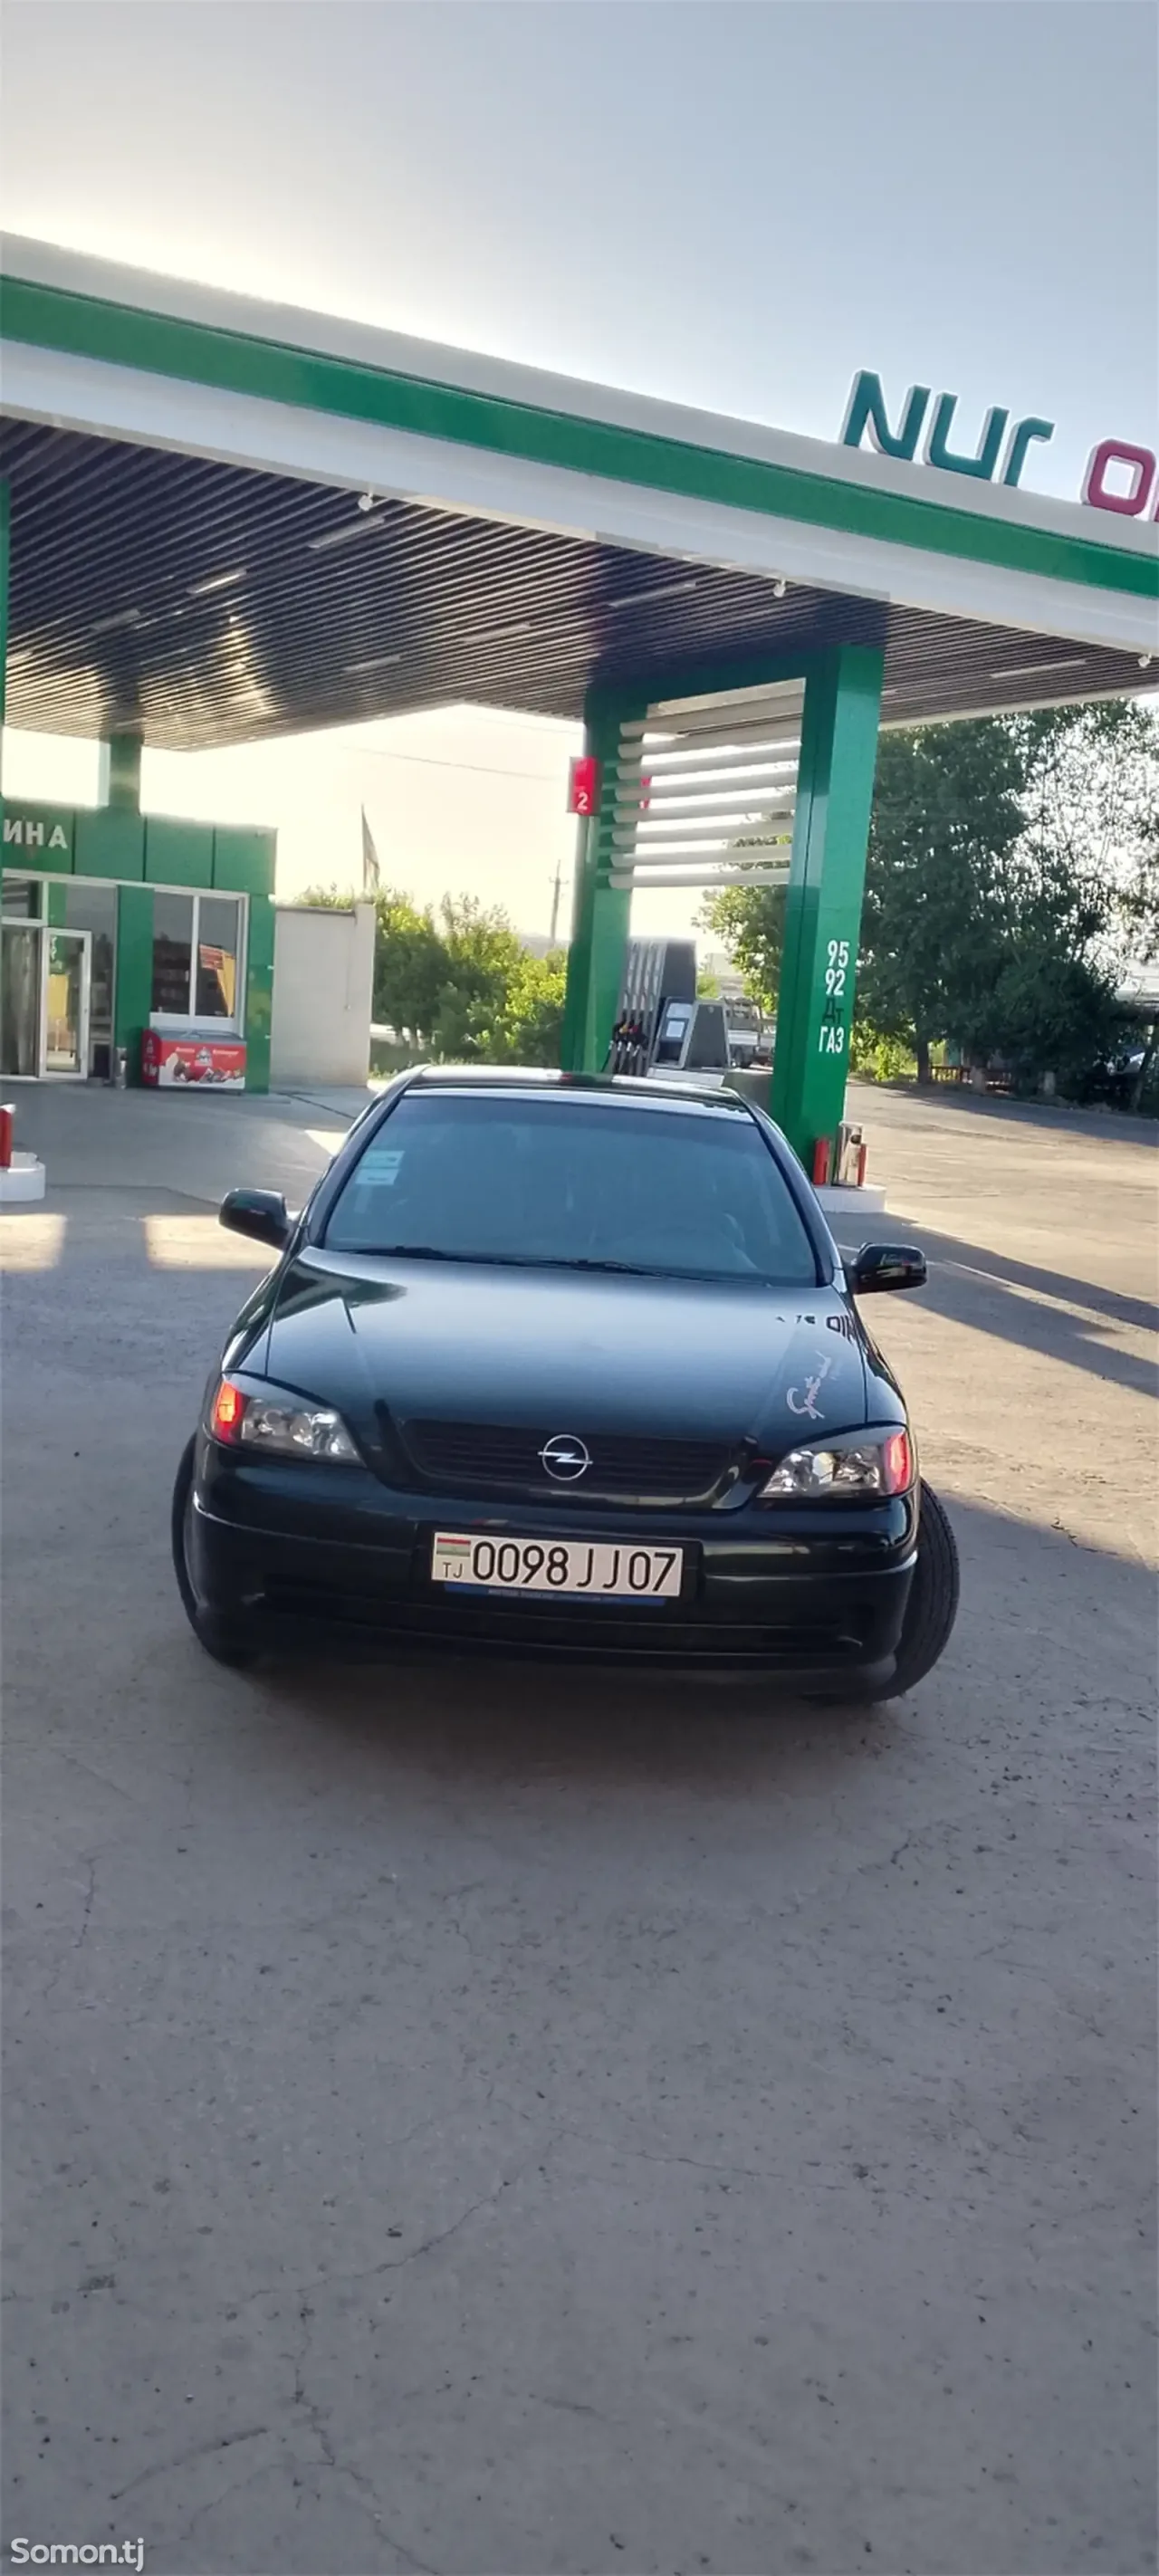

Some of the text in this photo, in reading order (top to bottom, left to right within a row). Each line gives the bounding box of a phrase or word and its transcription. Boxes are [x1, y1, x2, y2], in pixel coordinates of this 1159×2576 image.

[577, 791, 589, 810] 2
[828, 940, 850, 968] 95
[825, 968, 846, 996] 92
[819, 1026, 845, 1053] ГАЗ
[442, 1562, 464, 1579] TJ
[473, 1541, 676, 1592] 0098JJ07
